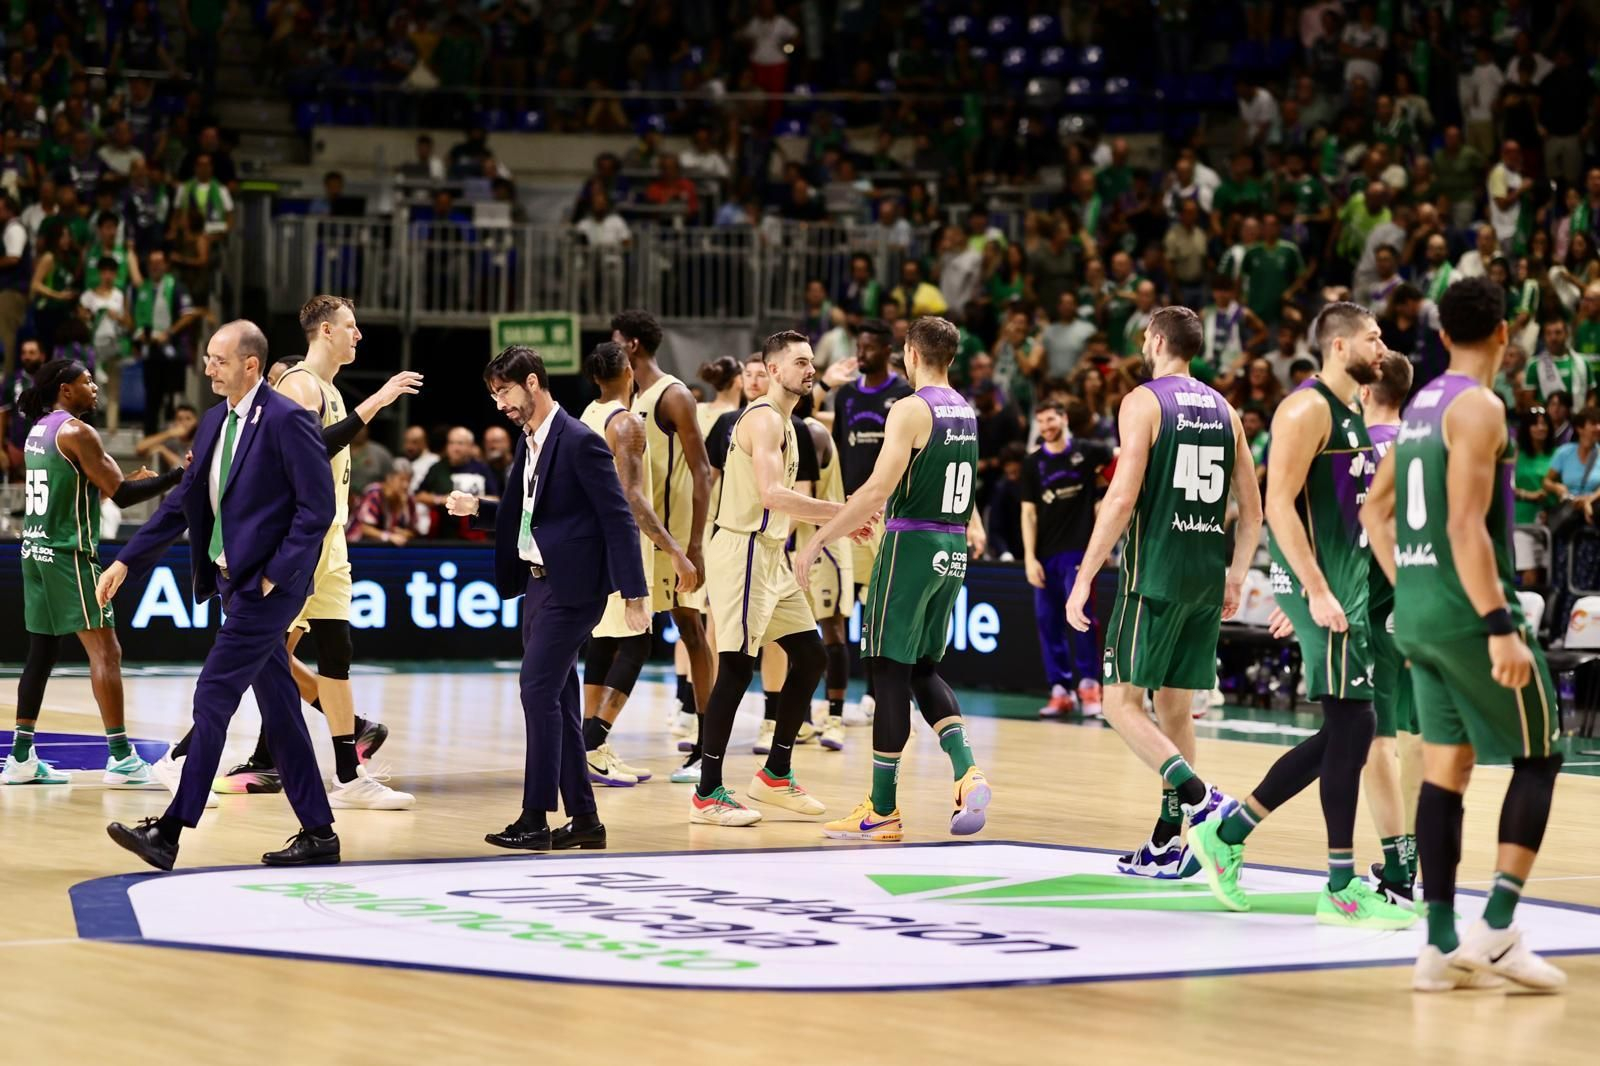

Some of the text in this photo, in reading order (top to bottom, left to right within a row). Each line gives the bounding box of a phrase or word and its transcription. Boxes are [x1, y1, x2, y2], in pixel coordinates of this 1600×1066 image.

[25, 469, 49, 516] 55
[941, 461, 973, 514] 19
[1173, 443, 1225, 504] 45
